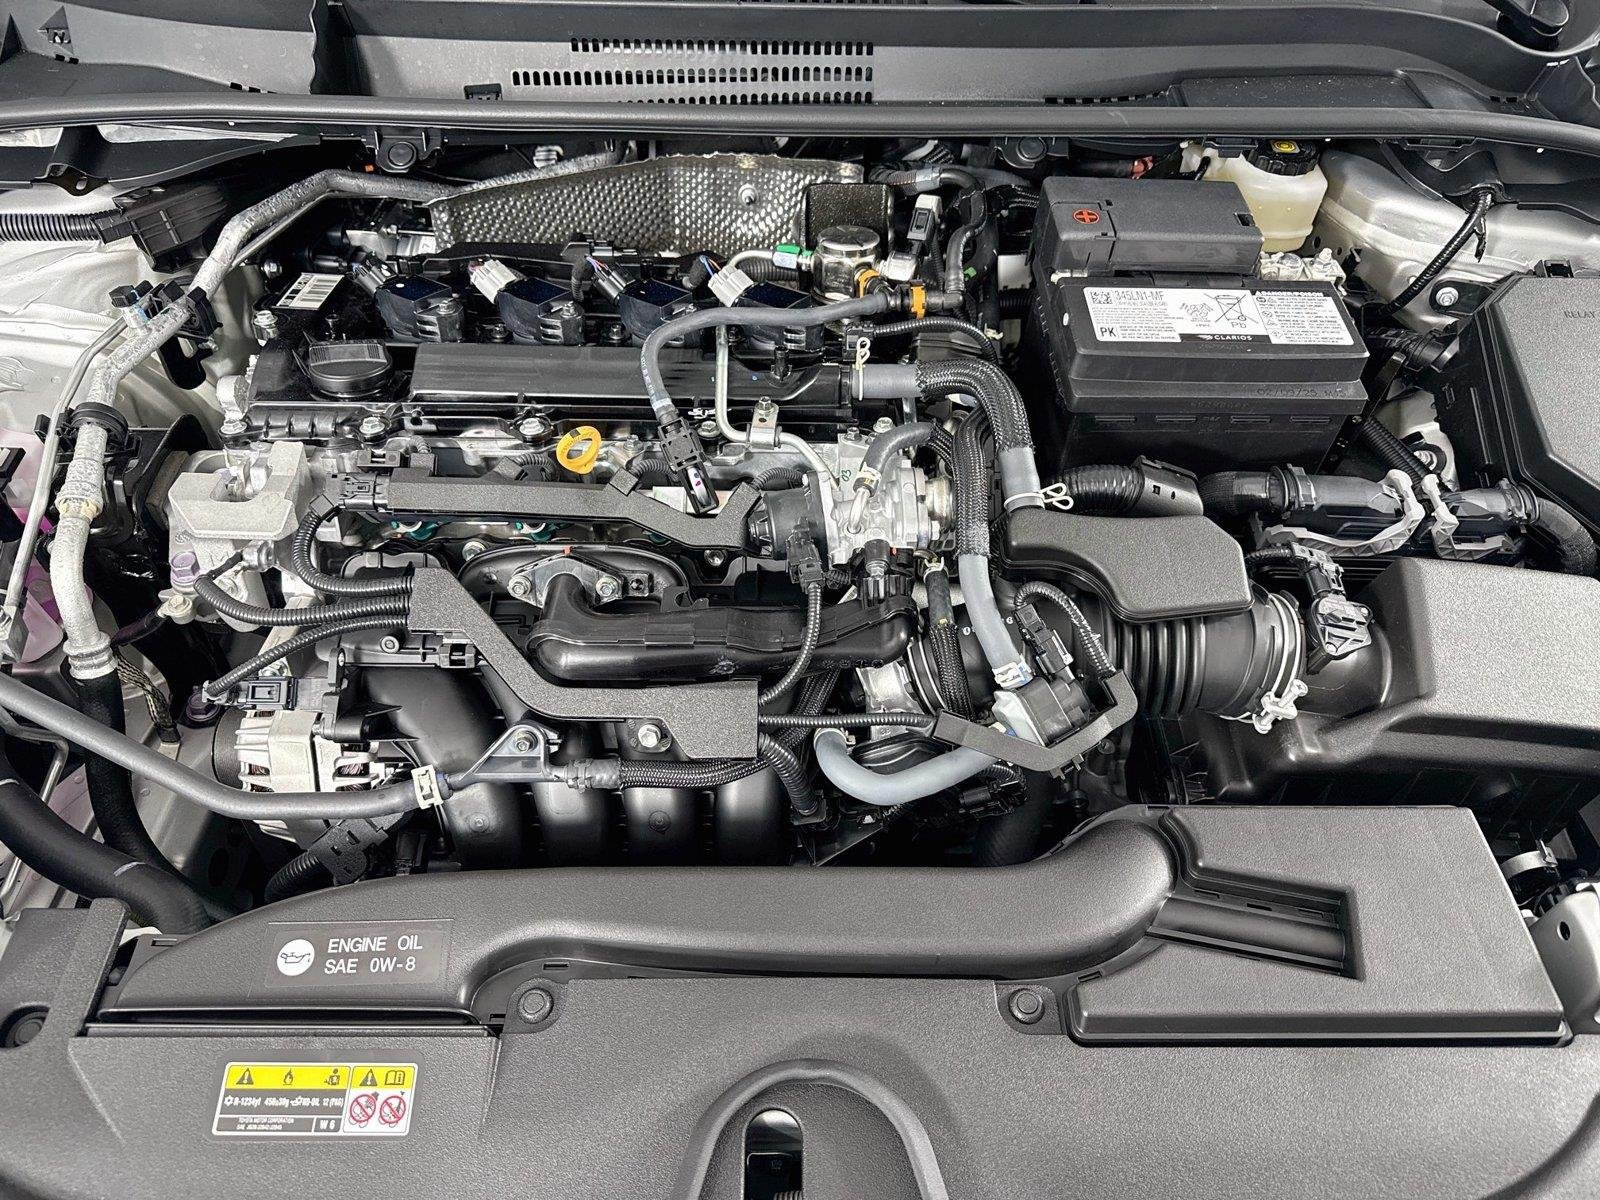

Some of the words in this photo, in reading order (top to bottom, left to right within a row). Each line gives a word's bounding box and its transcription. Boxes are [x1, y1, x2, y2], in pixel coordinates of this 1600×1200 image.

[1231, 321, 1247, 329] Pb
[1099, 326, 1117, 338] PK
[328, 936, 387, 953] ENGINE
[398, 935, 423, 951] OIL
[324, 958, 358, 974] SAE
[370, 956, 416, 973] 0W-8
[319, 1119, 329, 1130] W
